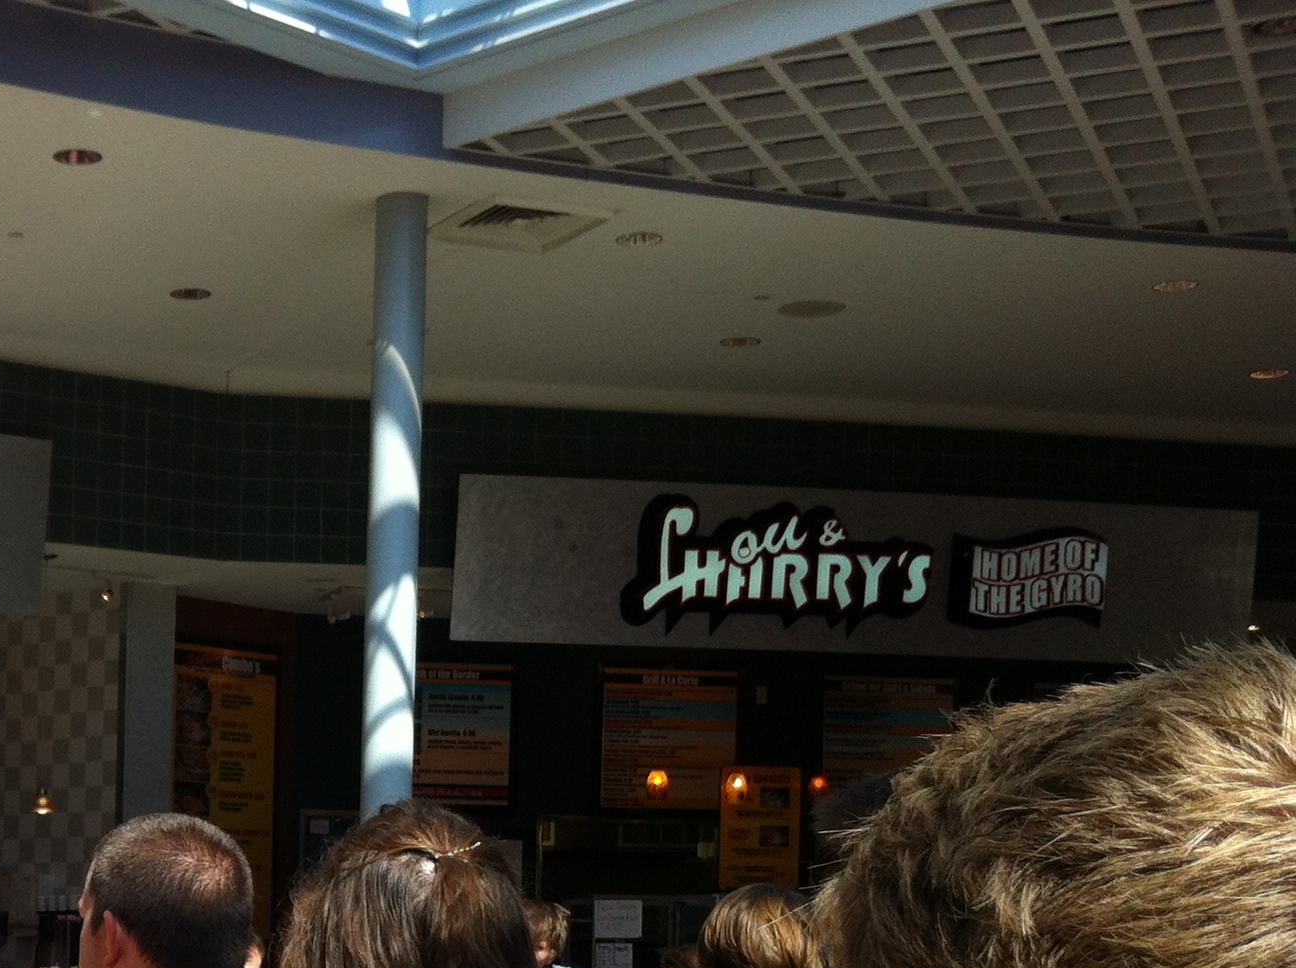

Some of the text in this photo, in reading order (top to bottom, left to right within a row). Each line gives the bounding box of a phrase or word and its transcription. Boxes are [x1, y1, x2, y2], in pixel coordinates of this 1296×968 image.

[642, 505, 846, 613] Lou &
[680, 549, 933, 613] HARRY'S
[981, 539, 1099, 582] HOME OF
[973, 573, 1104, 616] THE GYRO
